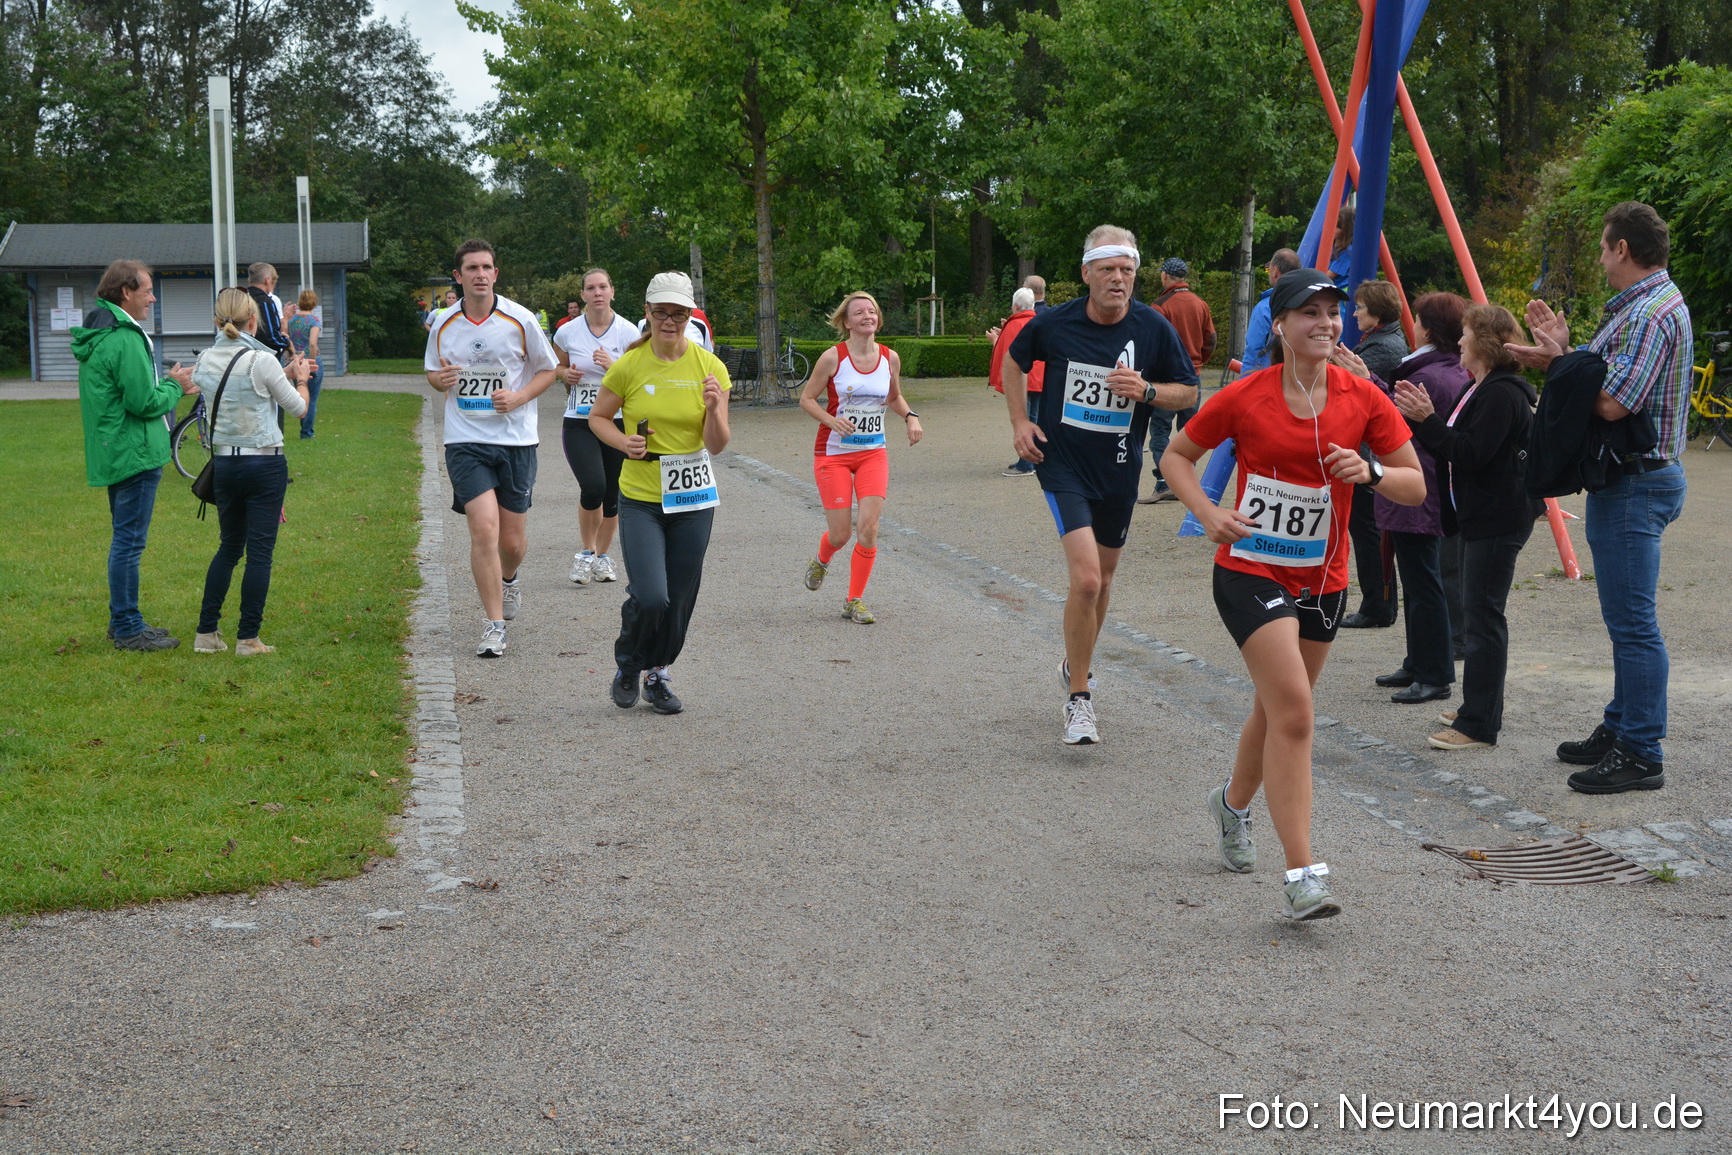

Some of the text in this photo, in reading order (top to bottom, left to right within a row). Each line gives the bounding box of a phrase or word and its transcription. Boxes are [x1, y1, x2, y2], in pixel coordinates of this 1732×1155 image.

[1069, 368, 1093, 378] PARTL
[1083, 410, 1111, 424] Bernd
[661, 460, 683, 468] PARTL
[668, 463, 711, 491] 2653
[675, 493, 709, 505] Dorothea
[1246, 482, 1321, 505] PARTL Neumarkt
[1245, 496, 1326, 537] 2187
[1254, 537, 1306, 556] Stefanie
